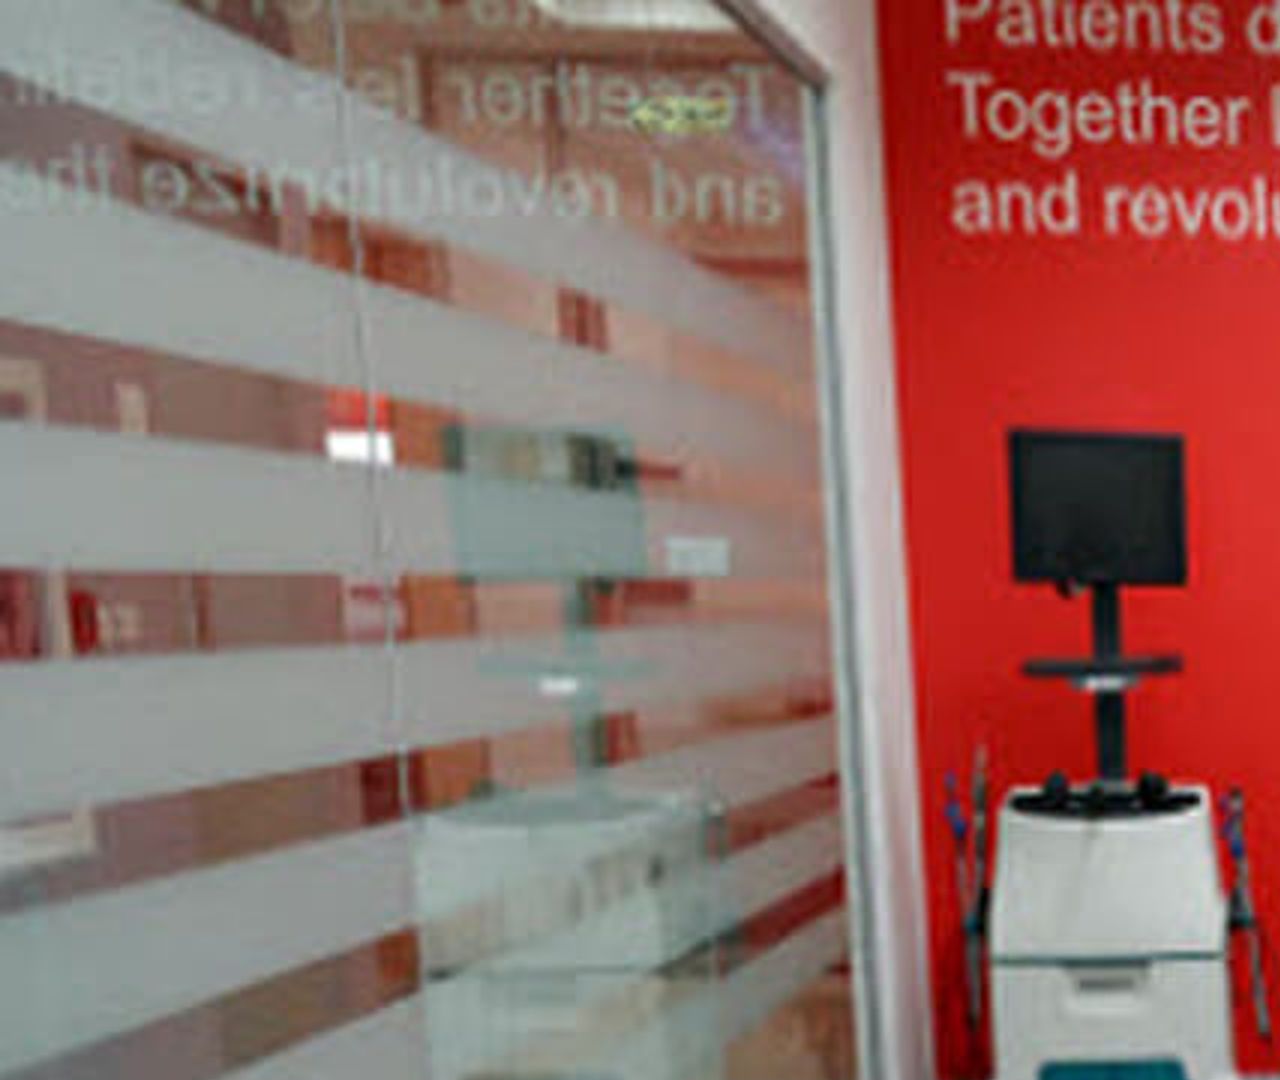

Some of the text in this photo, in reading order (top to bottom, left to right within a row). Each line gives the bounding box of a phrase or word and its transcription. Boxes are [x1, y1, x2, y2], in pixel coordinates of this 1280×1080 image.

[944, 0, 1224, 51] Patients
[945, 71, 1250, 158] Together
[952, 168, 1081, 234] and
